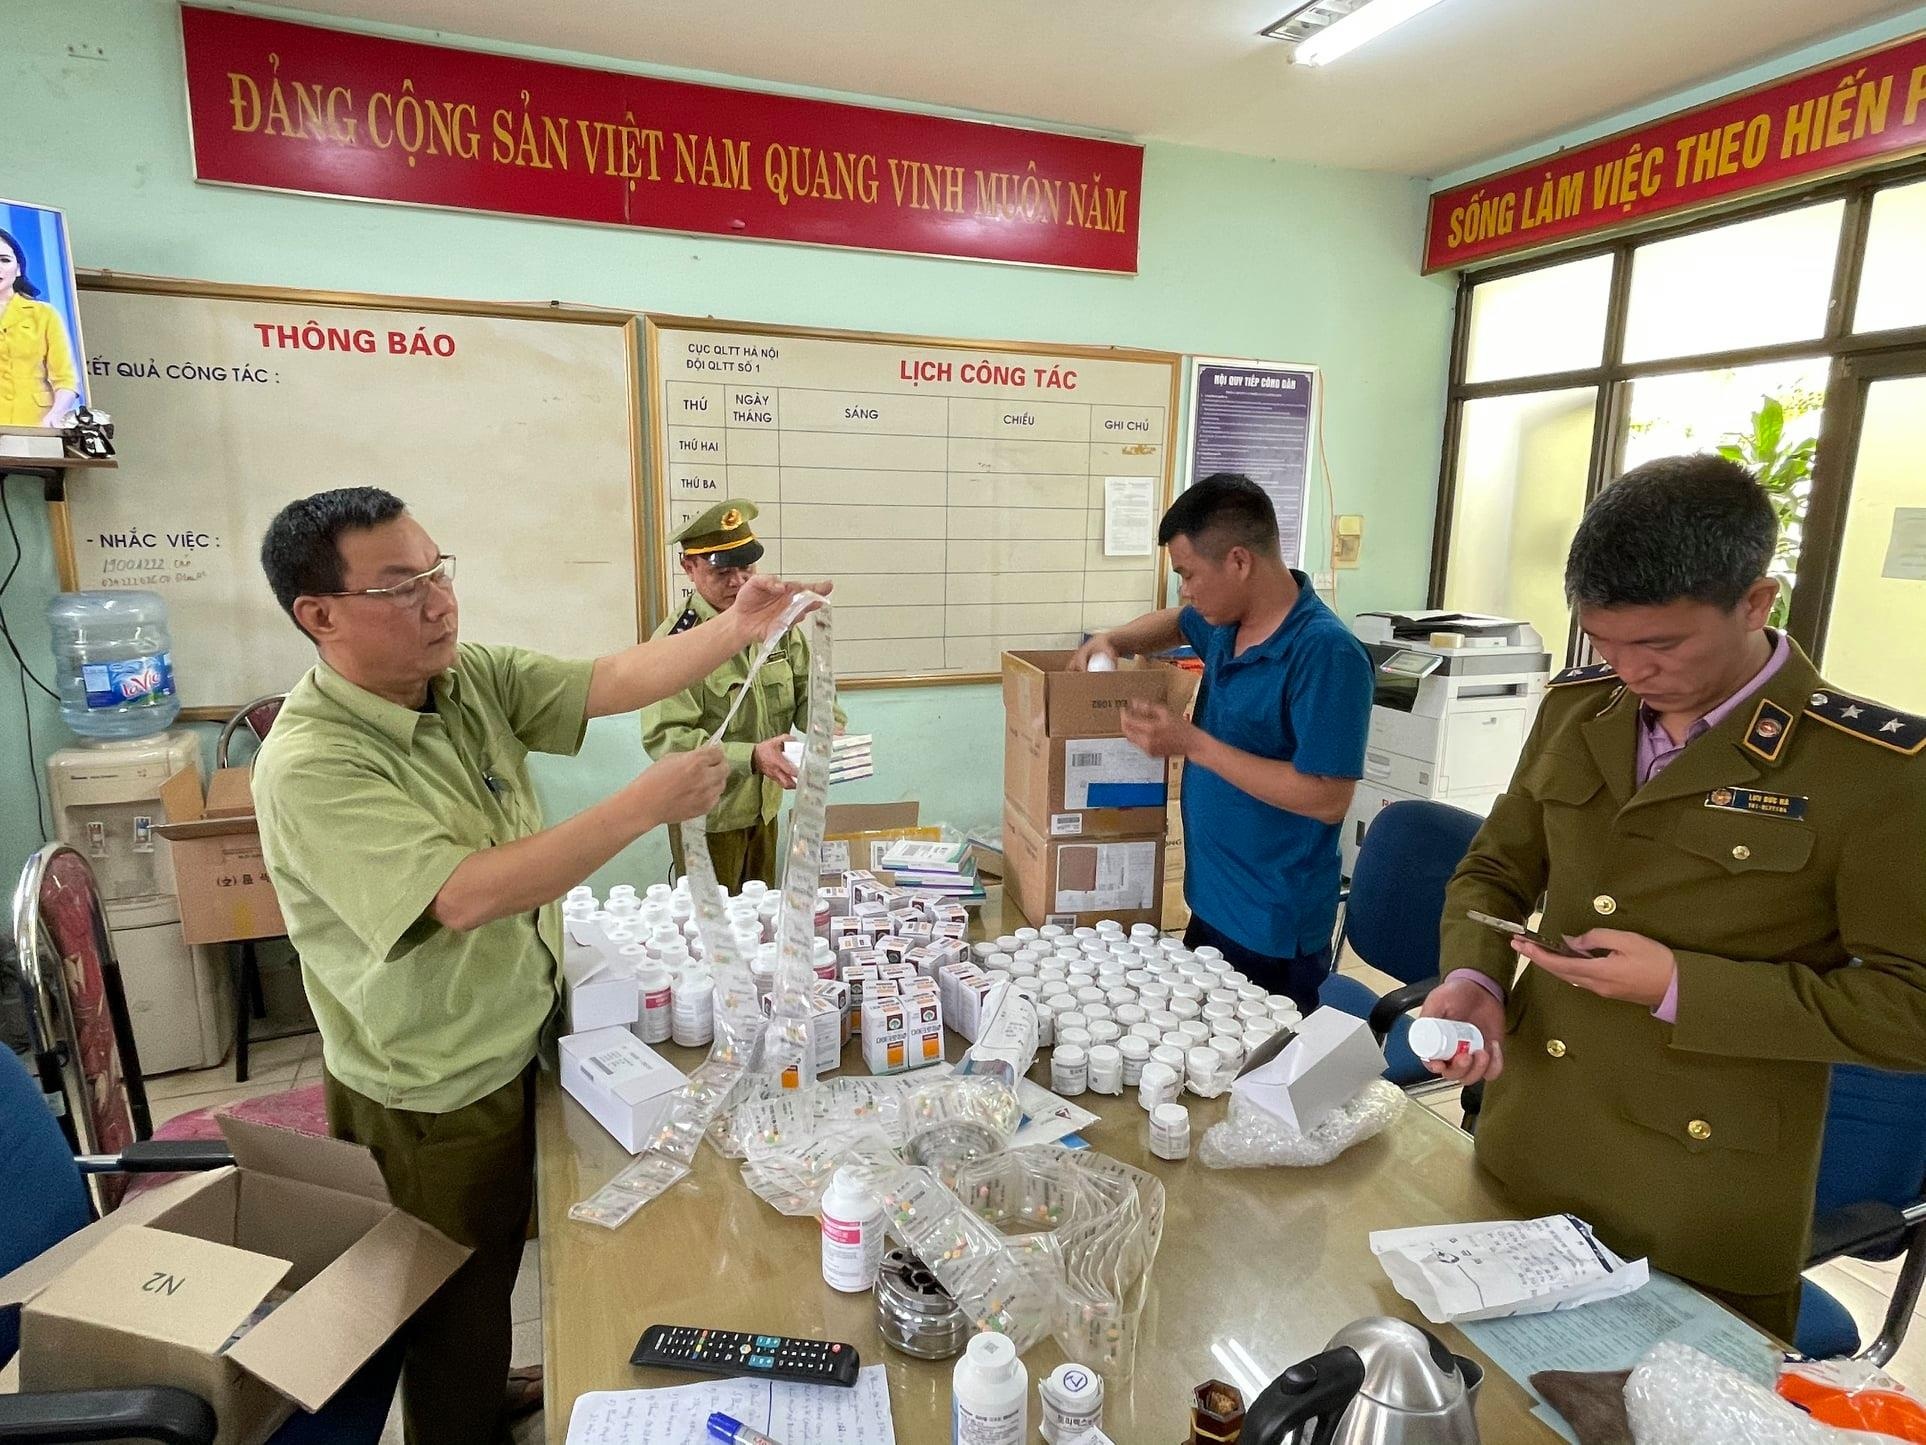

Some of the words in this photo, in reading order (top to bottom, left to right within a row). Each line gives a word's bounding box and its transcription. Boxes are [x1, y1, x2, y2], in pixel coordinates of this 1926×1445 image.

[227, 52, 357, 147] ĐẢNG
[367, 78, 481, 167] CỘNG
[492, 89, 569, 170] SẢN
[576, 111, 664, 192] VIỆT
[672, 132, 752, 191] NAM
[765, 142, 879, 206] QUANG
[888, 158, 965, 214] VINH
[974, 160, 1062, 225] MUÔN
[1065, 172, 1128, 233] NĂM
[1447, 188, 1515, 249] SỐNG
[1521, 171, 1585, 230] LÀM
[1593, 143, 1664, 212] VIỆC
[1676, 113, 1771, 188] THEO
[1780, 67, 1894, 160] HIẾN
[254, 320, 376, 353] THÔNG
[387, 326, 456, 357] BÁO
[688, 343, 711, 355] CỤC
[713, 345, 740, 357] QLTT
[743, 345, 759, 358] HÀ
[761, 347, 780, 360] NỘI
[116, 358, 161, 379] QUẢ
[166, 362, 227, 381] CÔNG
[232, 363, 268, 383] TÁC
[686, 358, 705, 370] ĐỘI
[708, 360, 735, 371] QLTT
[755, 363, 761, 373] 1
[900, 360, 952, 386] LỊCH
[960, 359, 1026, 387] CÔNG
[1033, 364, 1078, 390] TÁC
[683, 396, 708, 411] THỨ
[735, 391, 770, 406] NGÀY
[733, 408, 773, 423] THÁNG
[844, 404, 879, 420] SÁNG
[1003, 411, 1036, 426] CHIỀU
[1104, 419, 1124, 431] GHI
[1126, 418, 1149, 432] CHÚ
[679, 438, 698, 451] THỨ
[700, 440, 719, 452] HAI
[681, 475, 700, 489] THỨ
[702, 478, 717, 490] BA
[100, 526, 157, 549] NHẮC
[166, 530, 210, 551] VIỆC
[142, 1272, 186, 1296] N2
